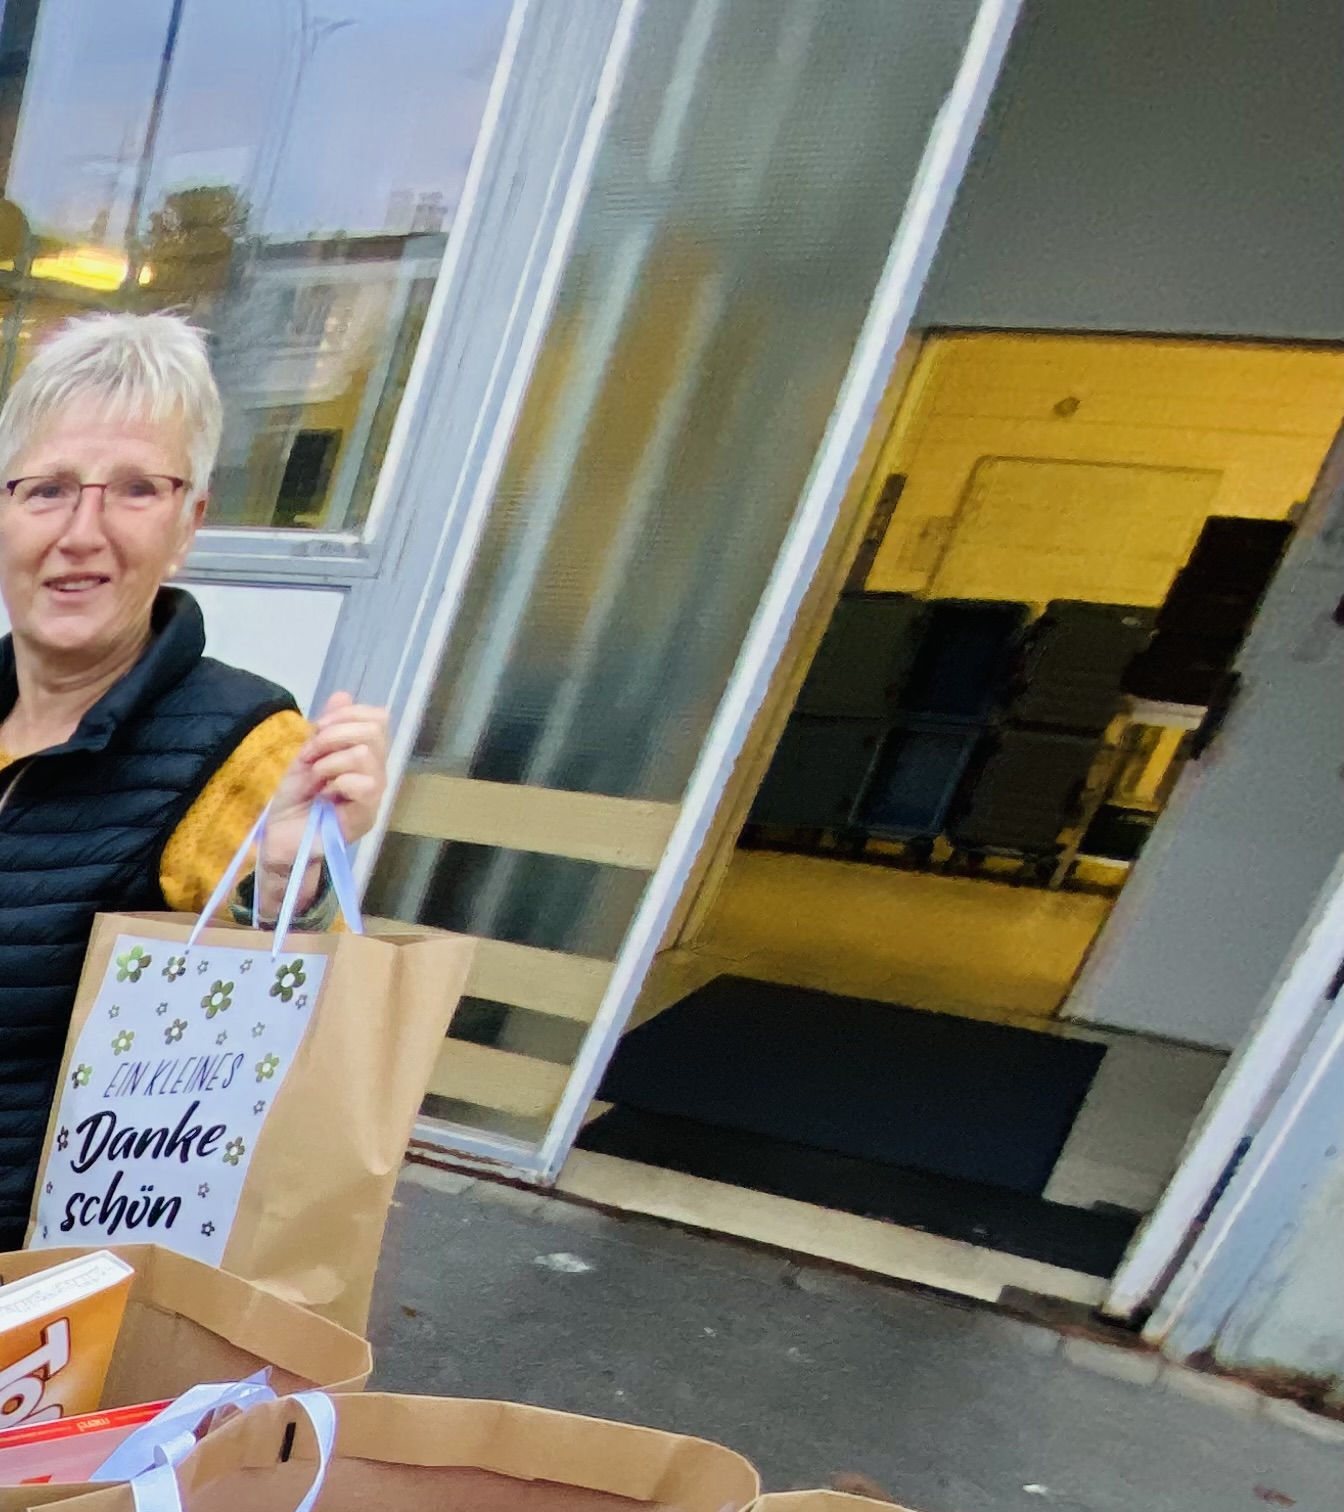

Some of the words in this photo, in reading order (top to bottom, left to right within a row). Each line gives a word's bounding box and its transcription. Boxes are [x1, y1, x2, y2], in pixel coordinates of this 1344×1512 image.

[103, 1061, 151, 1098] EIN
[144, 1053, 245, 1096] KLEINES
[70, 1100, 227, 1174] Danke
[60, 1170, 182, 1236] schön
